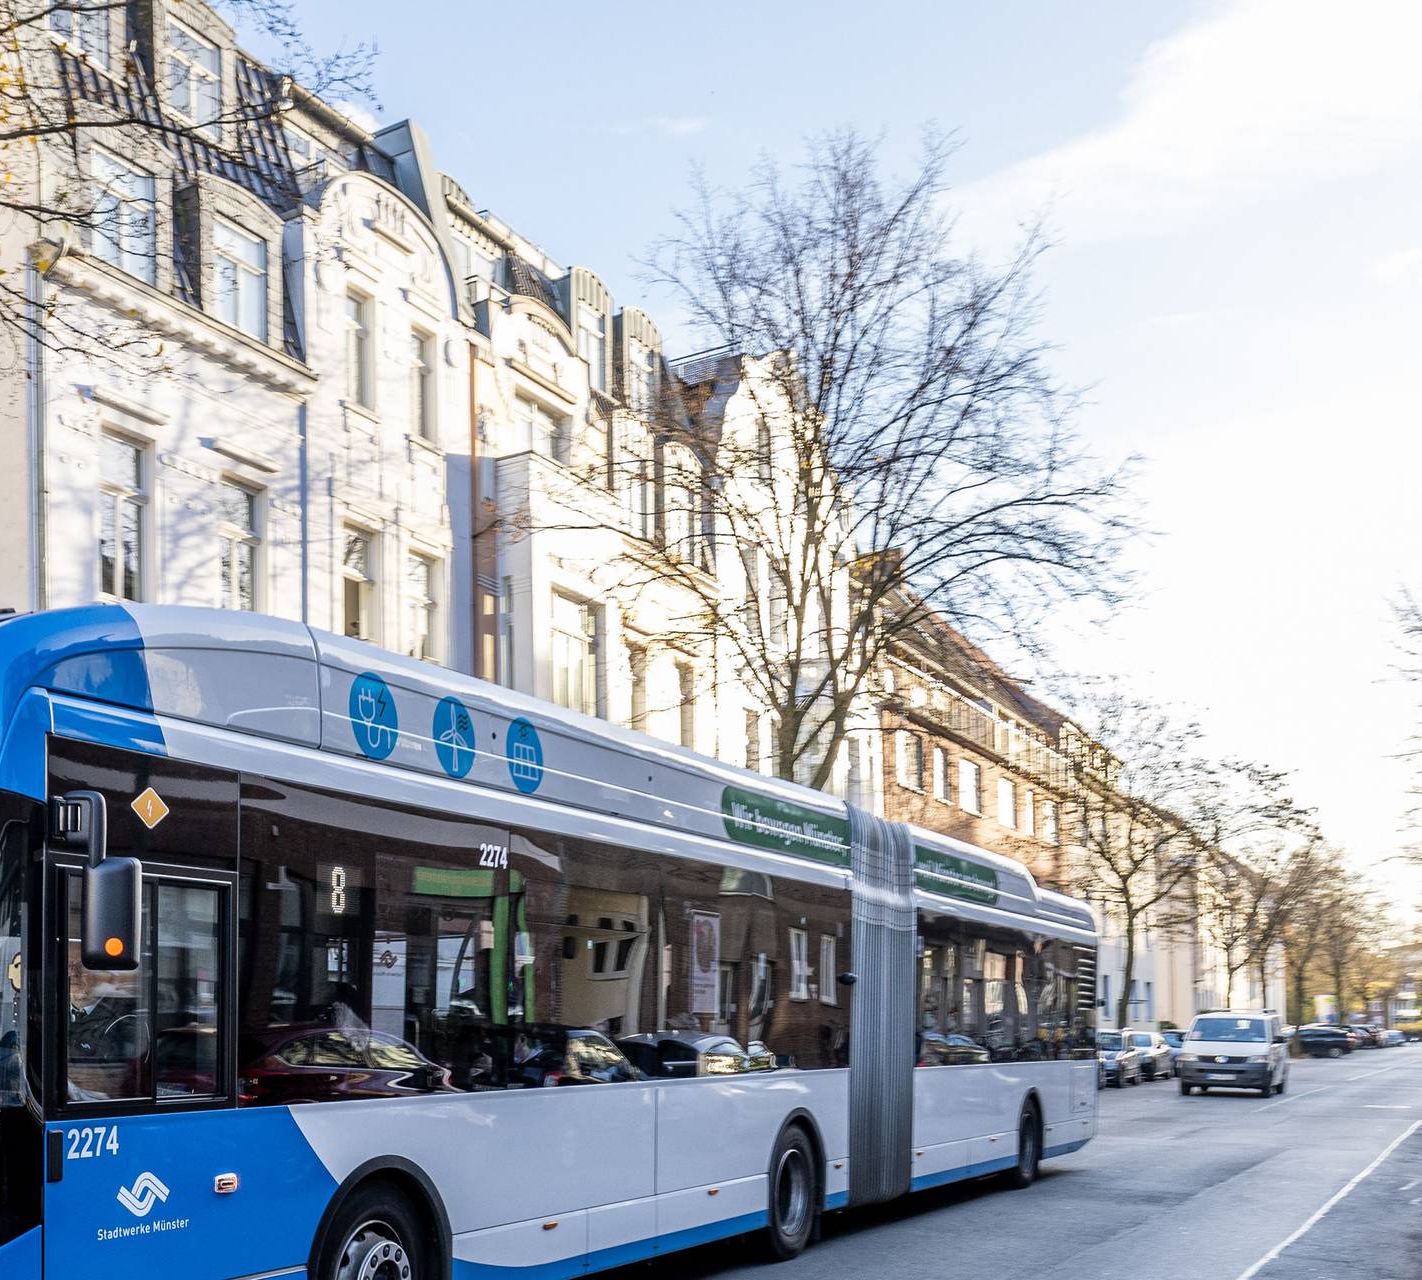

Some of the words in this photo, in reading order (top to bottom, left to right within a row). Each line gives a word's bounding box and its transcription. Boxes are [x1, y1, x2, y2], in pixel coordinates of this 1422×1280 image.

[479, 843, 508, 869] 2274
[331, 866, 345, 914] 8
[67, 1125, 119, 1160] 2274
[97, 1223, 151, 1241] Stadtwerke
[153, 1218, 190, 1233] Münster
